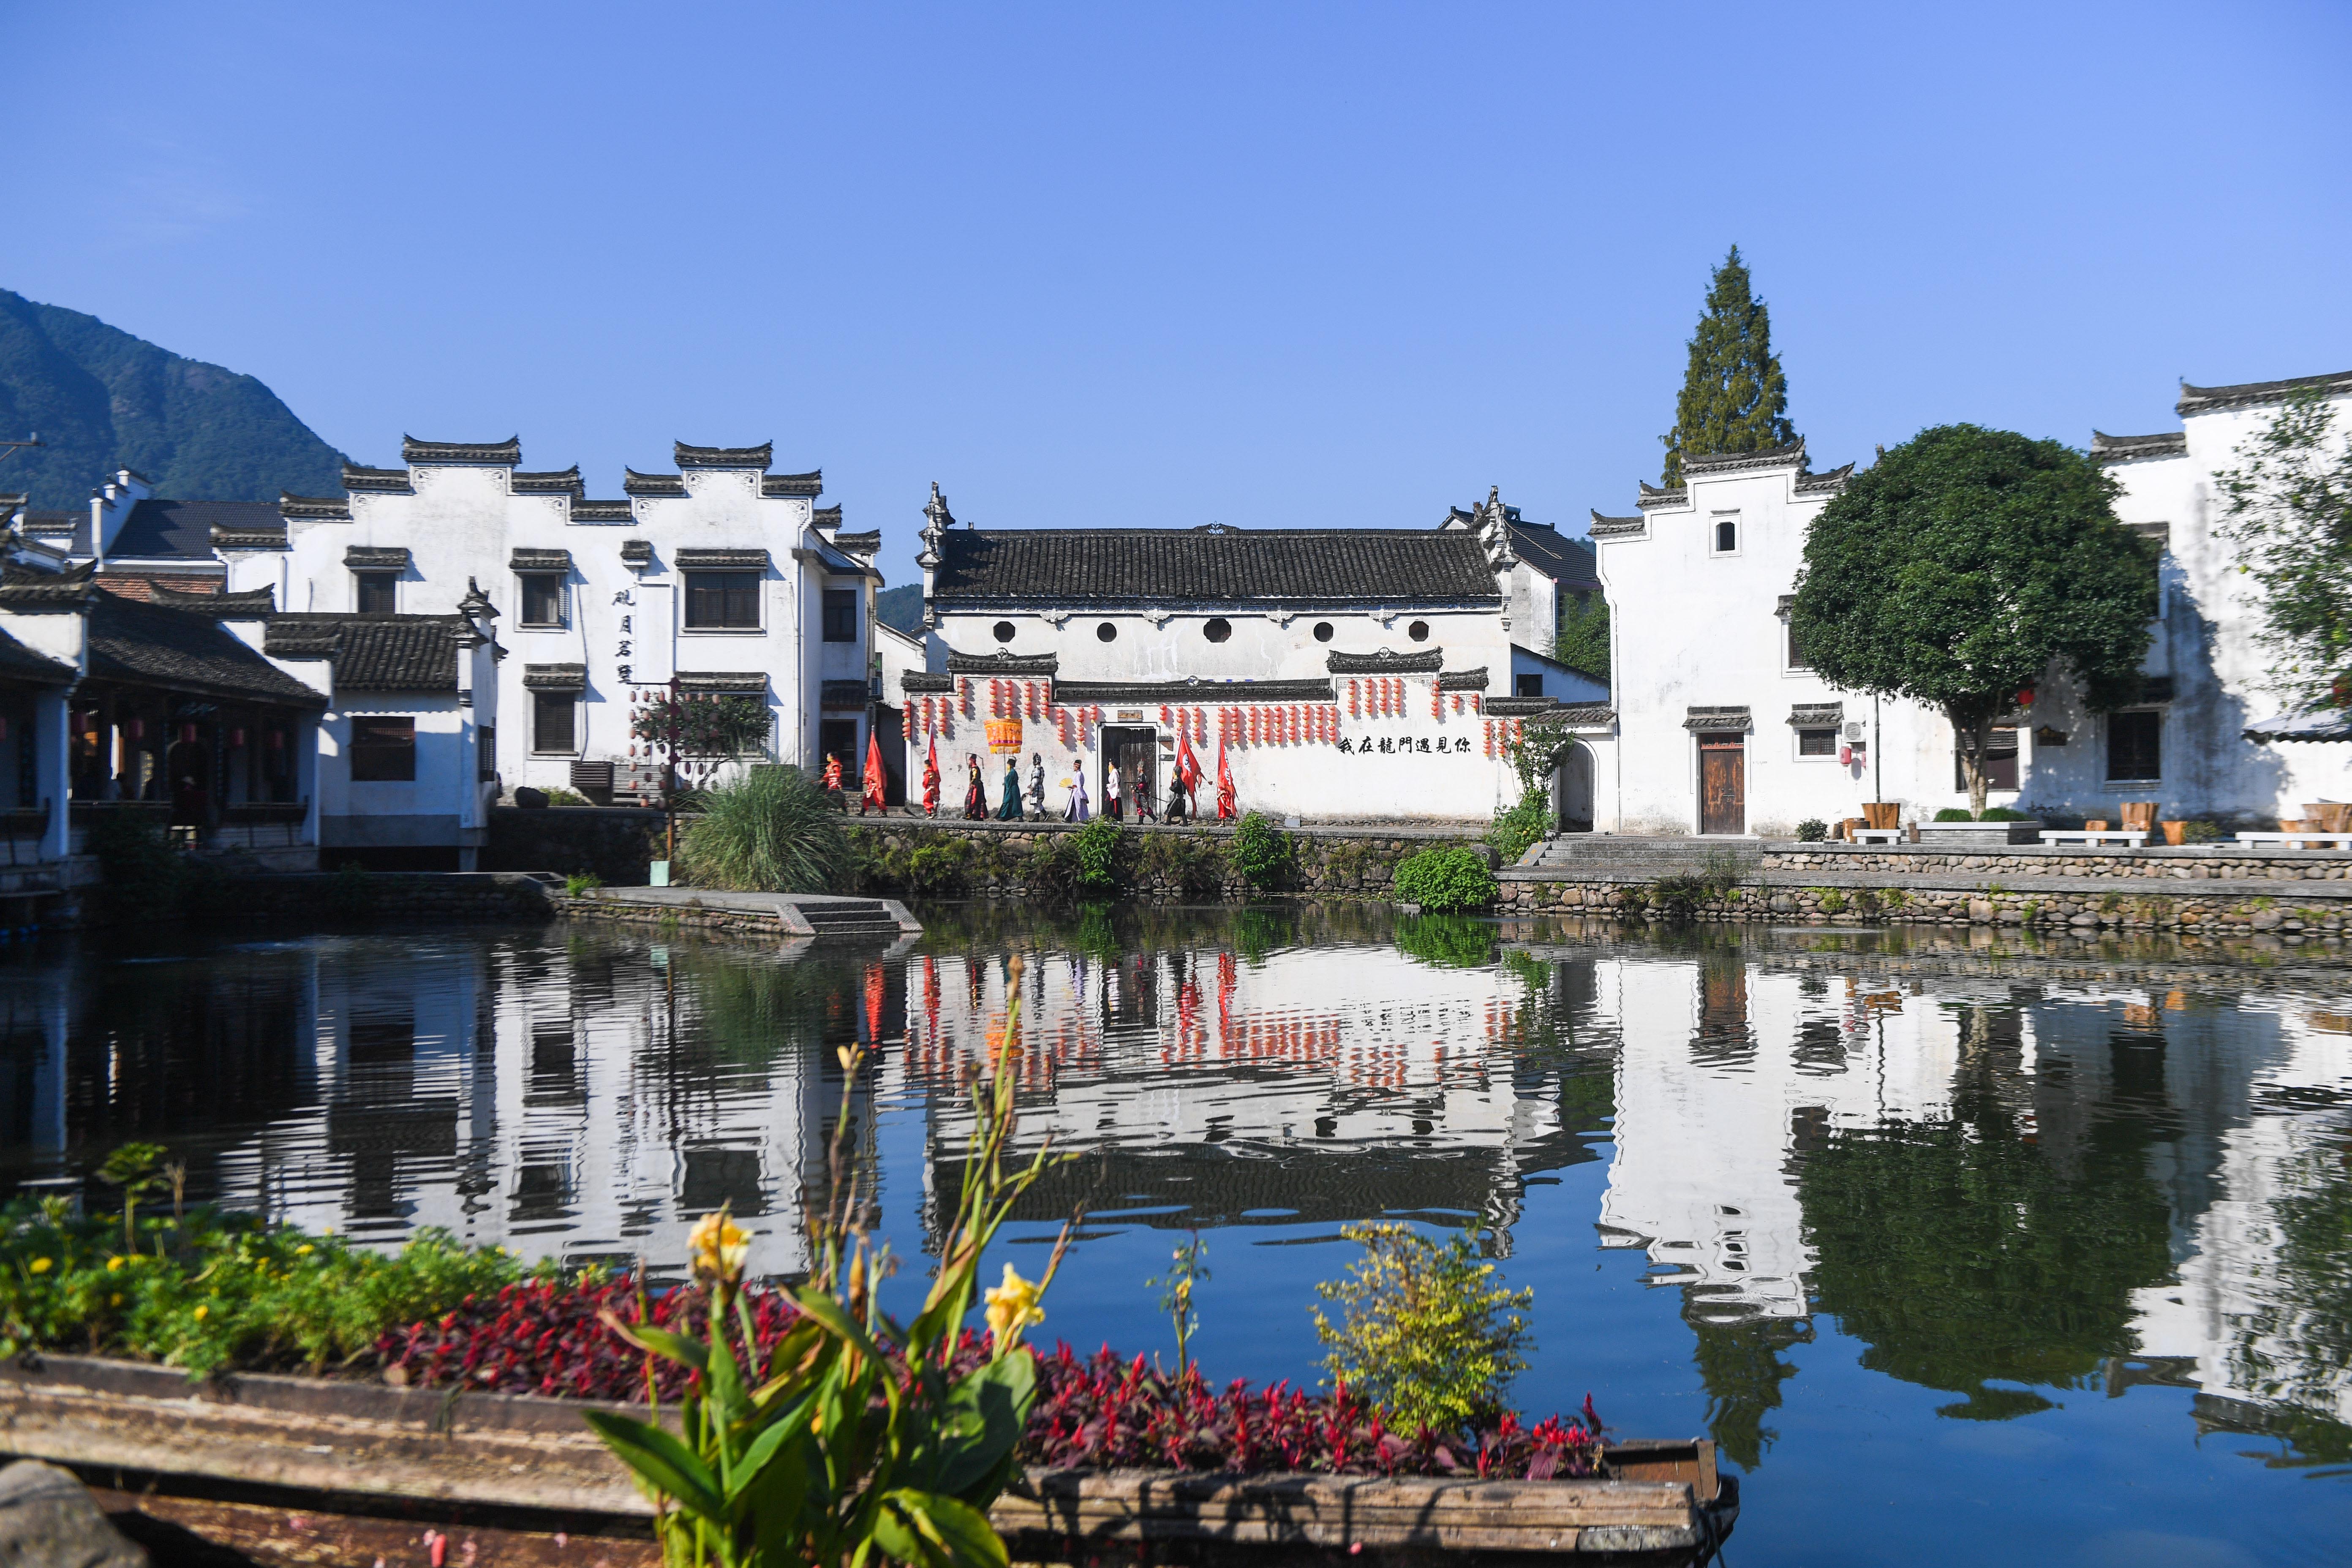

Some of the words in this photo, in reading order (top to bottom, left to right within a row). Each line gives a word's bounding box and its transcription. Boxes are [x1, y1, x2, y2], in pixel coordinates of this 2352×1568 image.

[1338, 736, 1471, 755] 我在龍門遇見你
